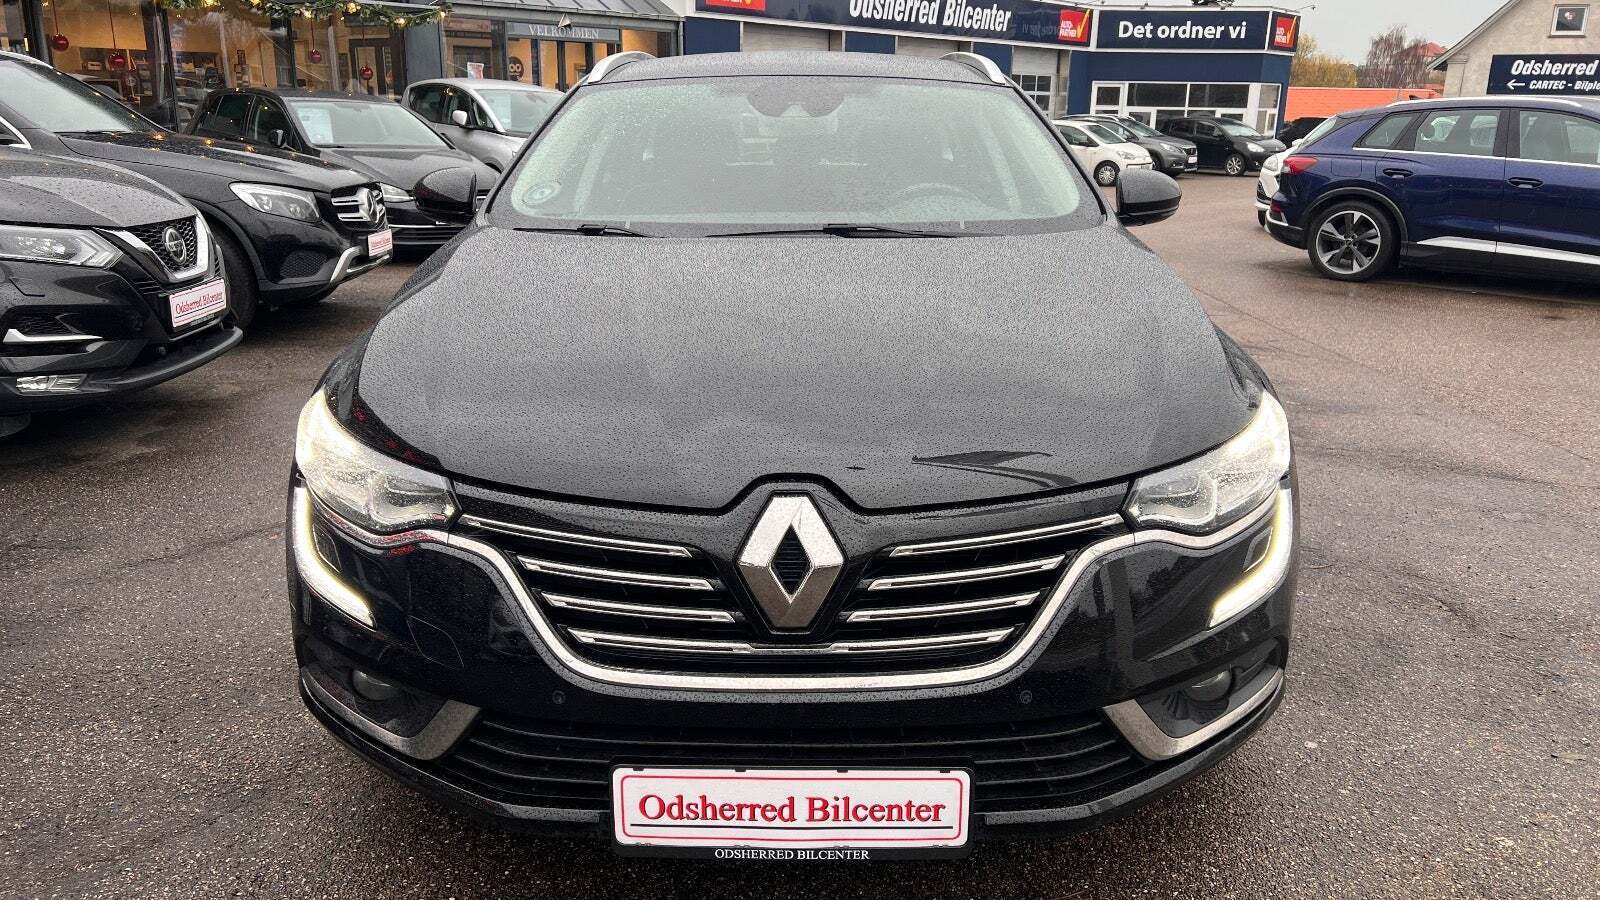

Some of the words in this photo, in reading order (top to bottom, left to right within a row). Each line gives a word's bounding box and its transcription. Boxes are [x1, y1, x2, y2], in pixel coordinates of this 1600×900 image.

[943, 0, 1012, 32] Bilcenter
[528, 24, 600, 39] VELKOMMEN
[1118, 20, 1153, 39] Det
[1157, 20, 1225, 39] ordner
[1229, 21, 1247, 39] vi
[1511, 59, 1600, 75] Odsherred
[1529, 80, 1566, 90] CARTEC
[639, 794, 797, 822] Odsherred
[806, 796, 946, 822] Bilcenter
[714, 848, 794, 860] ODSHERRED
[796, 849, 871, 860] BILCENTER
